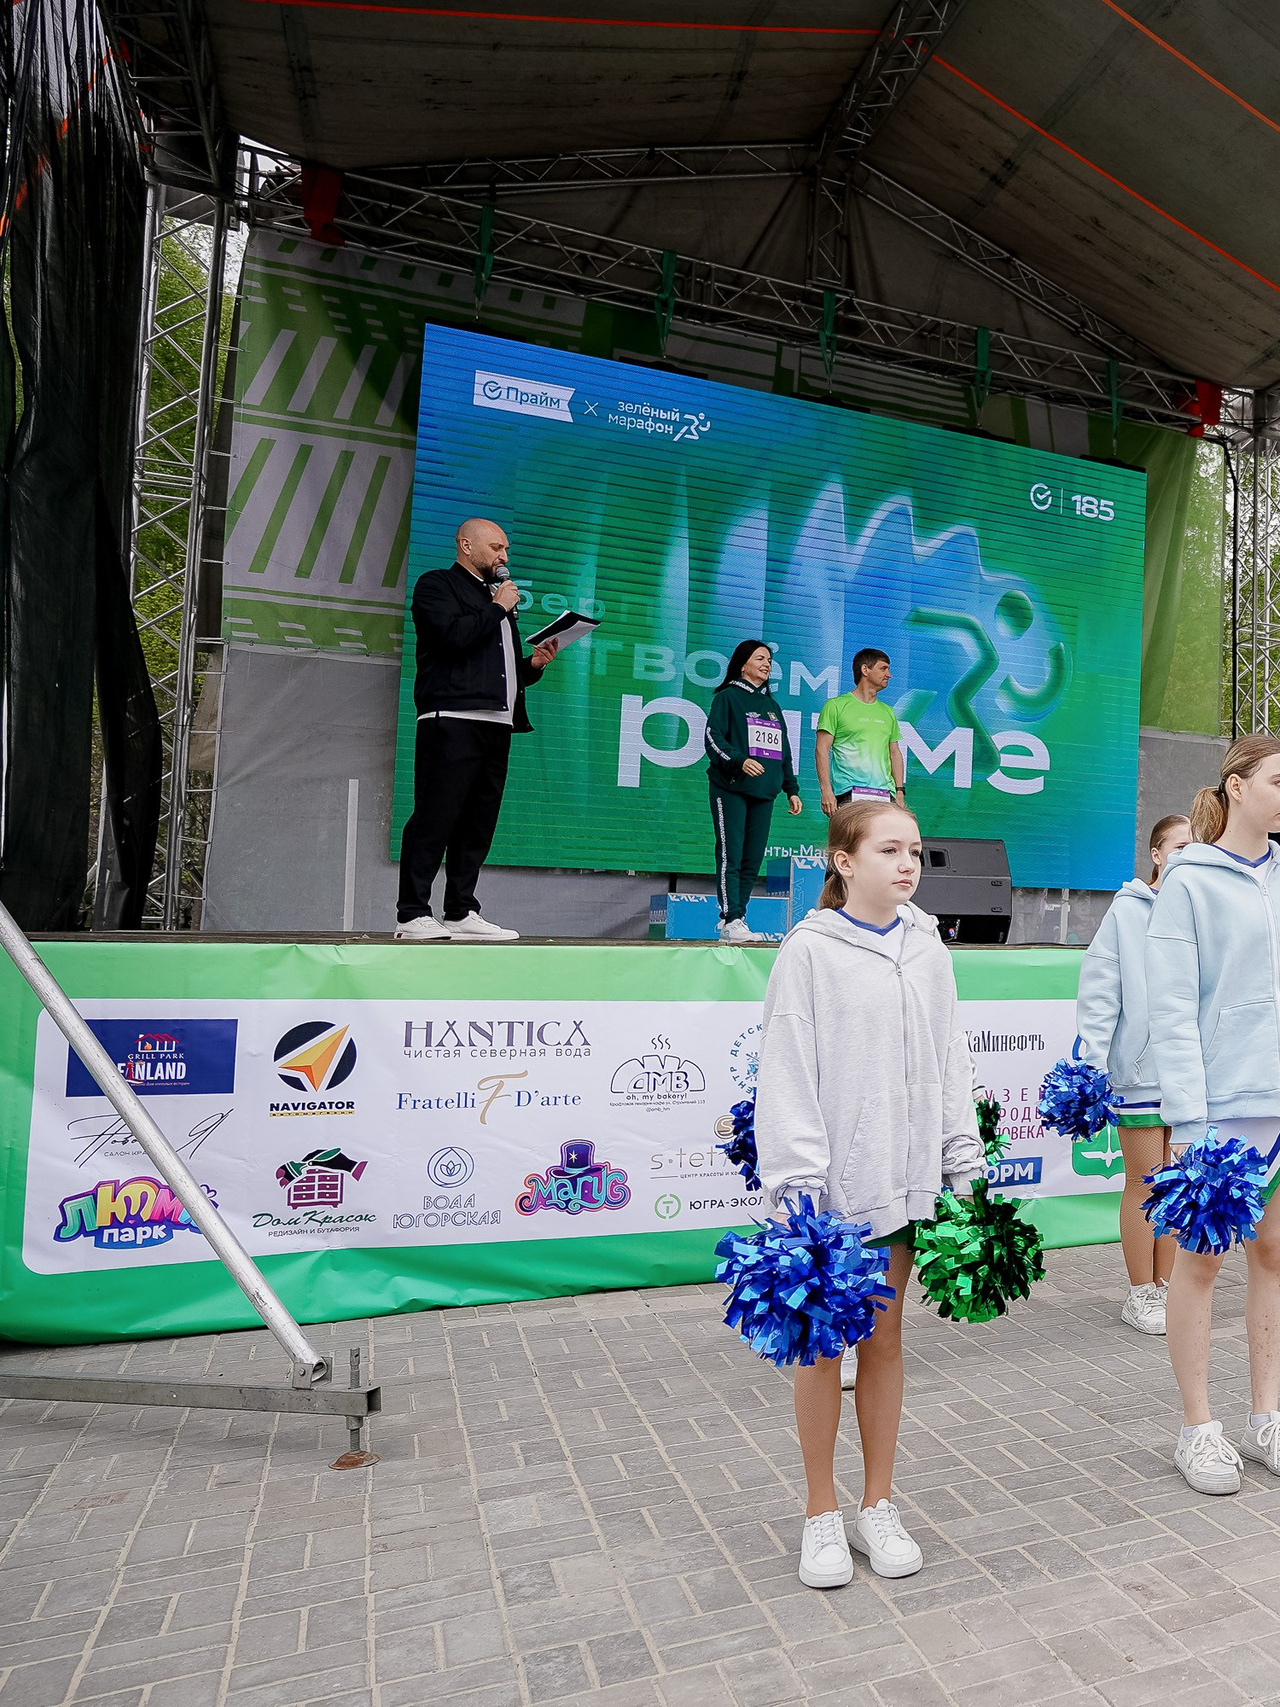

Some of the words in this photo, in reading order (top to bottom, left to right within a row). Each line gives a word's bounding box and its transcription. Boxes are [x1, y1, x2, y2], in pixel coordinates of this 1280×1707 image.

[506, 386, 561, 409] Прайм
[617, 401, 681, 421] зелёный
[608, 413, 674, 435] марафон
[1071, 494, 1115, 521] 185
[755, 730, 779, 745] 2186
[403, 1020, 592, 1048] HANTICA
[403, 1049, 461, 1059] чистая
[470, 1048, 547, 1060] северная
[555, 1047, 592, 1059] вода
[729, 1066, 754, 1095] ЕНТР
[269, 1100, 356, 1112] NAVIGATOR
[396, 1091, 477, 1110] Fratelli
[626, 1093, 639, 1101] oh,
[422, 1193, 477, 1211] ВОДА
[689, 1196, 765, 1211] ЮГРА-ЭКОЛ
[392, 1209, 502, 1229] ЮГОРСКАЯ
[102, 1223, 167, 1245] парк
[268, 1228, 309, 1238] РЕДИЗАЙН
[317, 1226, 361, 1235] БУТАФОРИЯ
